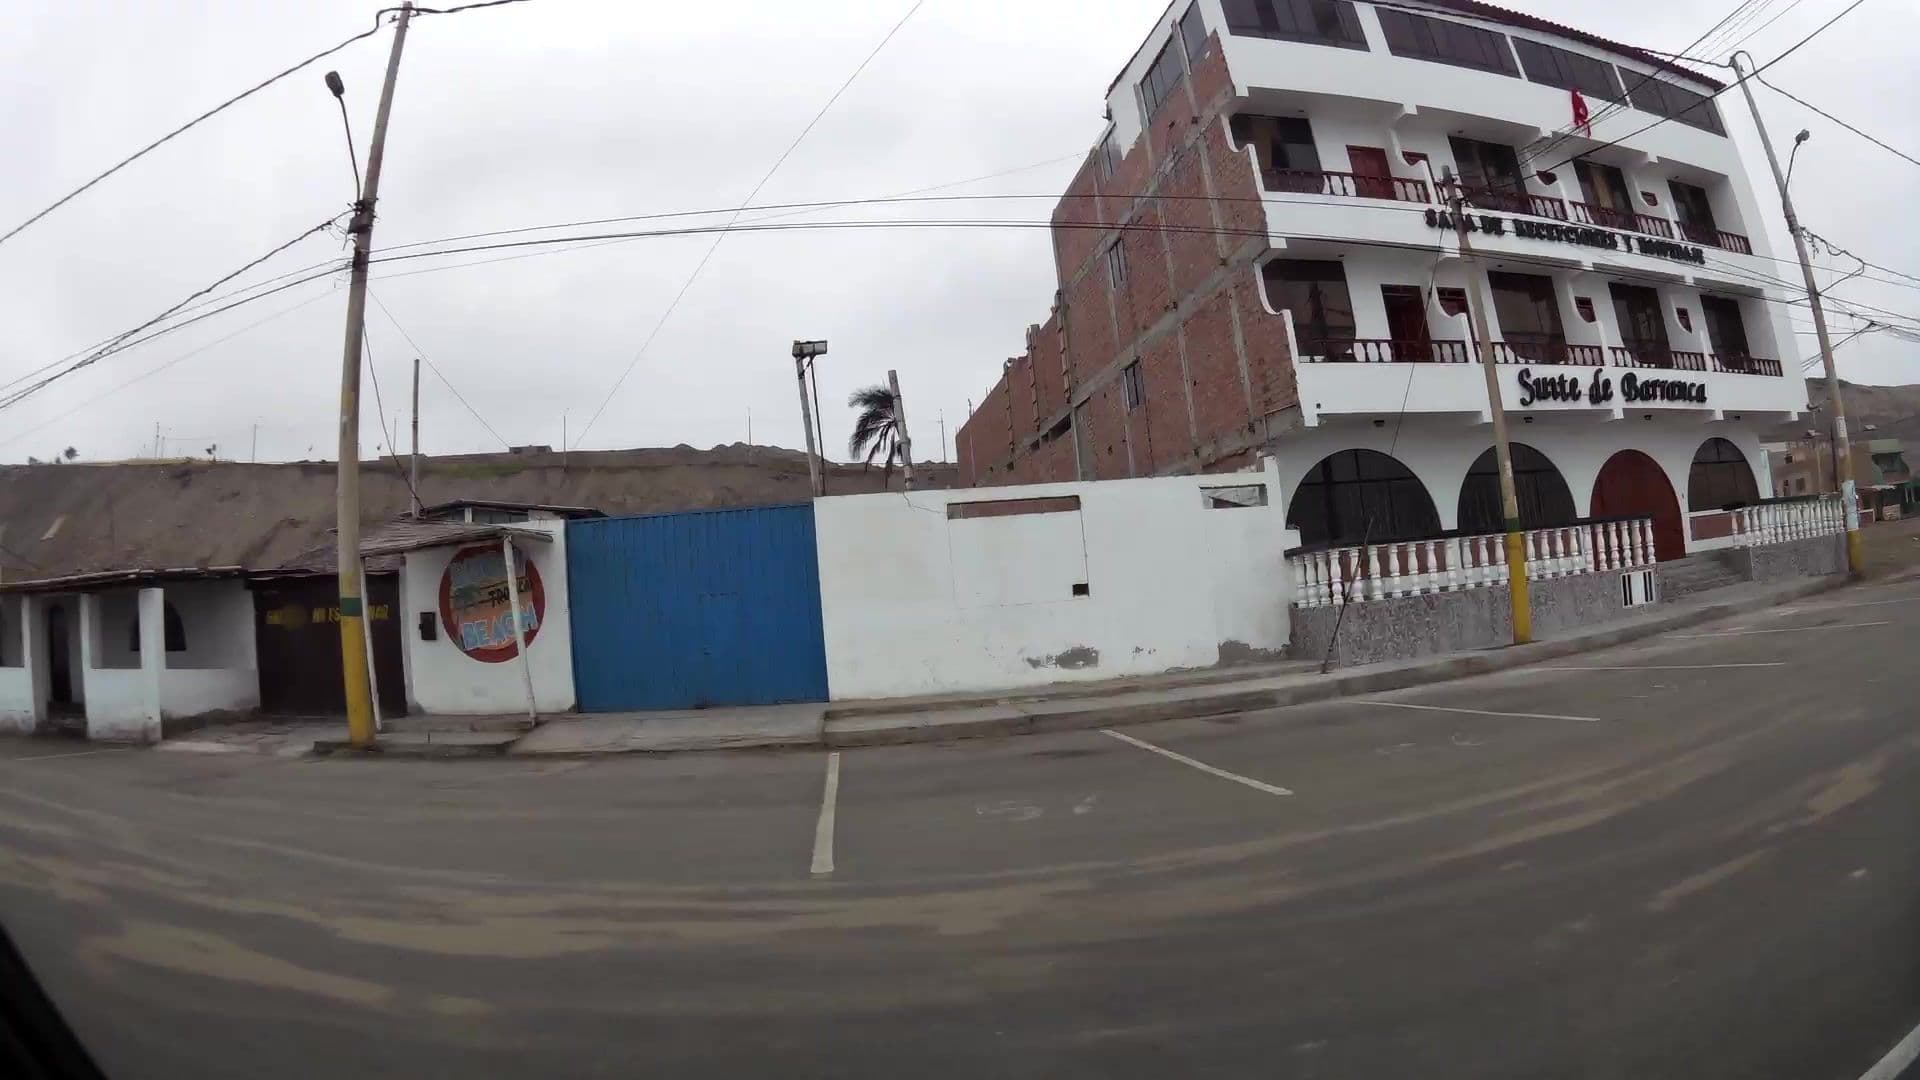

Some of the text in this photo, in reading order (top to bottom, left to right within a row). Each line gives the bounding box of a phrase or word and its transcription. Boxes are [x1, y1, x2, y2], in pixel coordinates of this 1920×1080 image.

[1479, 215, 1505, 236] DE
[1622, 233, 1633, 253] Y
[1518, 367, 1707, 406] Suite de Barranca
